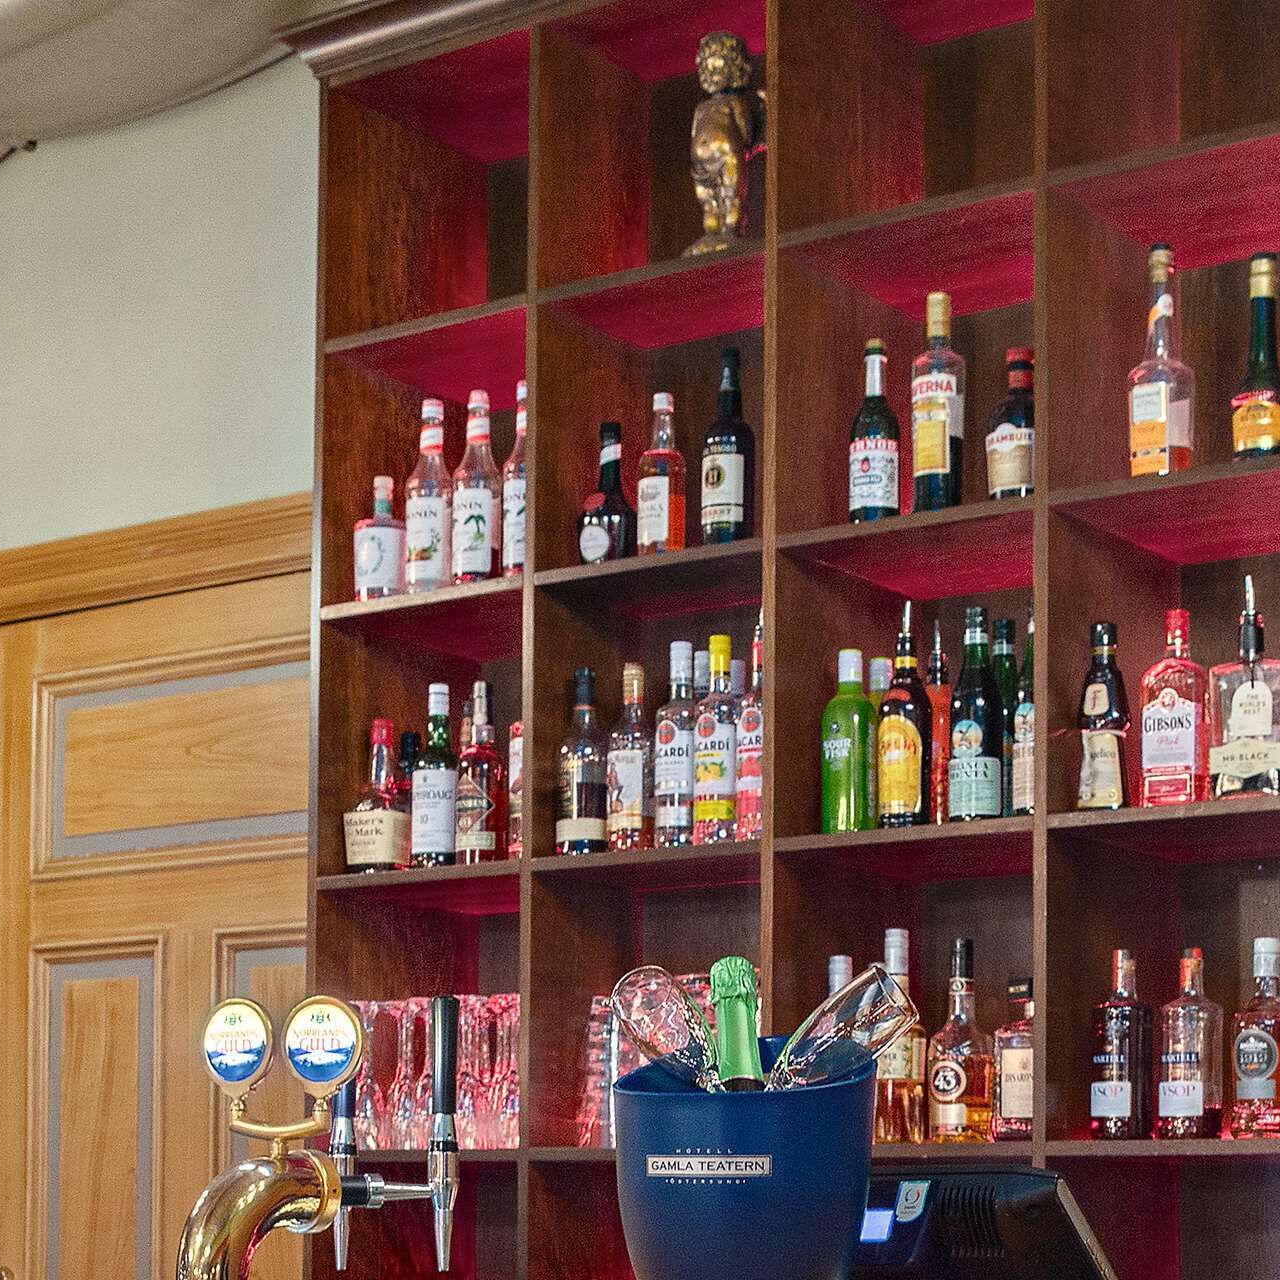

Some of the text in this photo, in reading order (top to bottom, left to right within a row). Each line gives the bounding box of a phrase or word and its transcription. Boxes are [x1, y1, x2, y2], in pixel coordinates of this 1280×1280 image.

[934, 1069, 956, 1090] 43
[651, 1160, 766, 1171] GAMLA TEATERN
